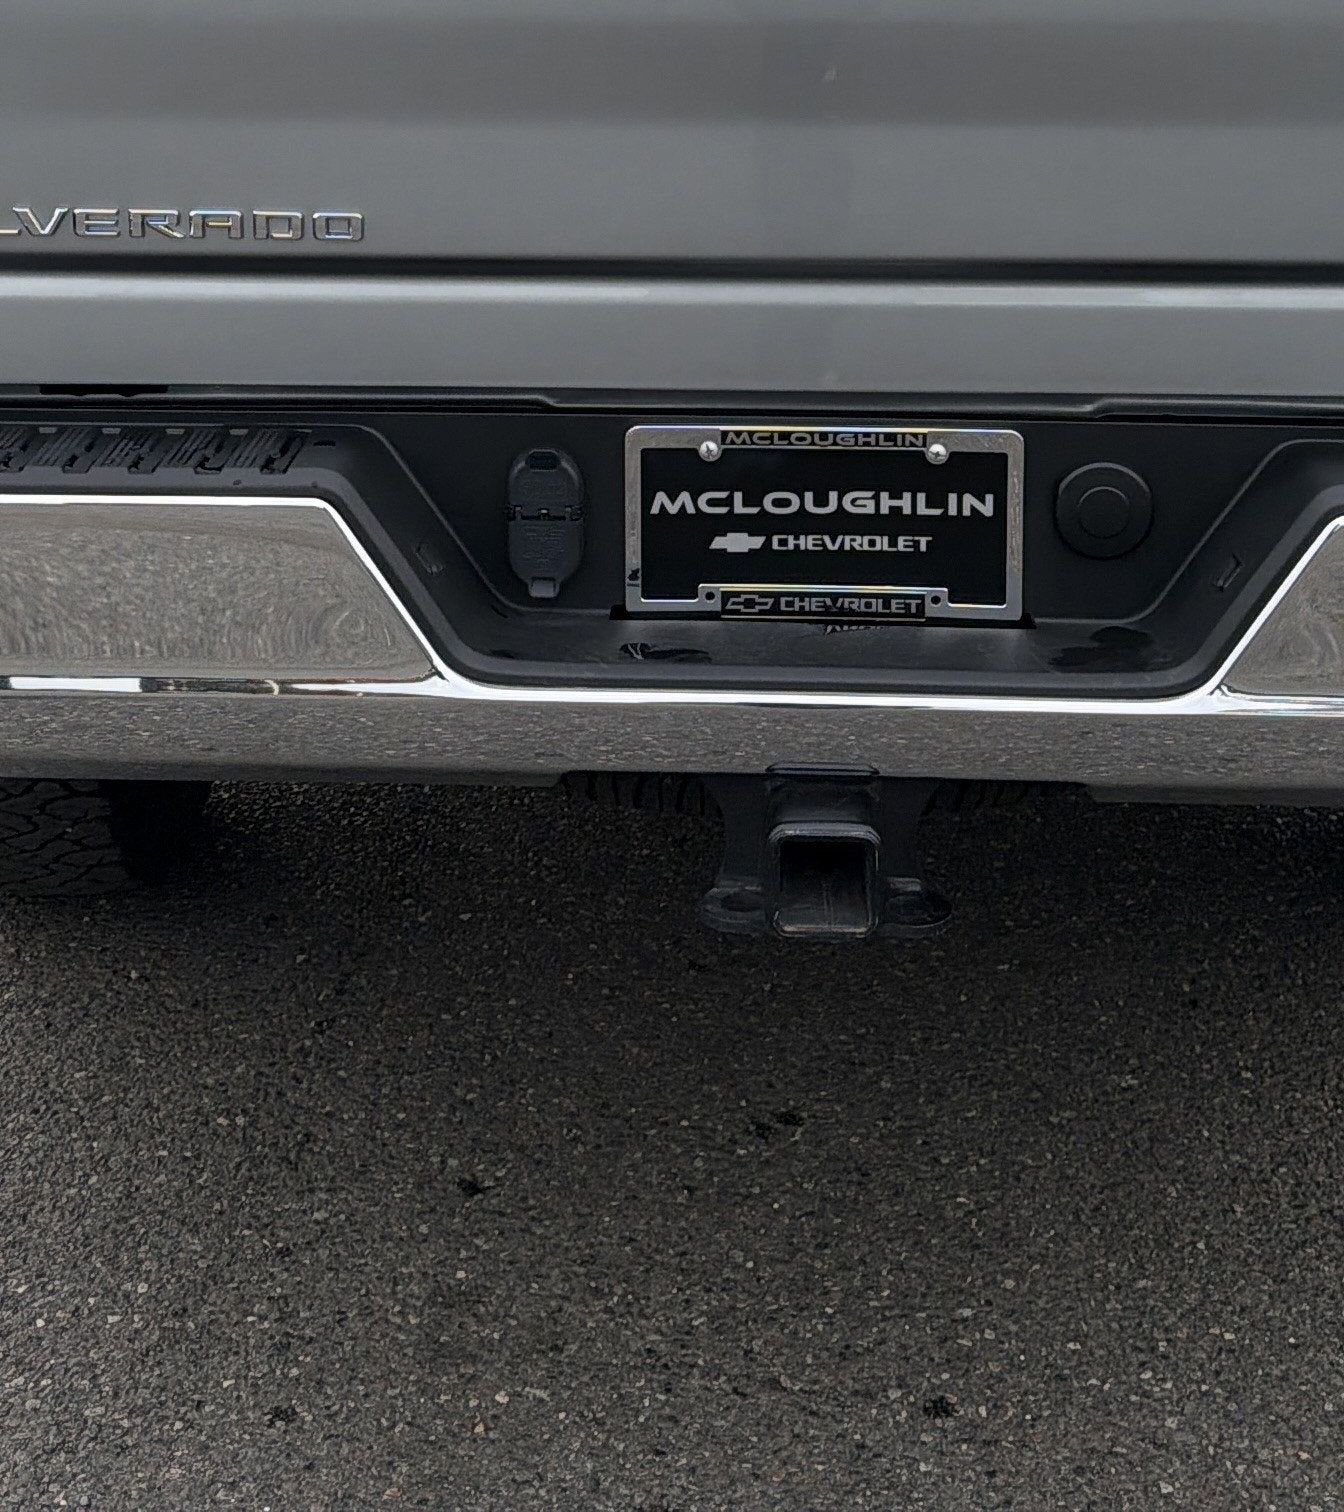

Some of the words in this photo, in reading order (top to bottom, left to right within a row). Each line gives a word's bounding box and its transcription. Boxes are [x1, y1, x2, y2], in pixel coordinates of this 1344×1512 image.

[725, 431, 926, 448] MCLOUGHLIN
[649, 490, 995, 518] MCLOUGHLIN
[771, 533, 933, 553] CHEVROLET
[779, 596, 922, 615] CHEVROLET
